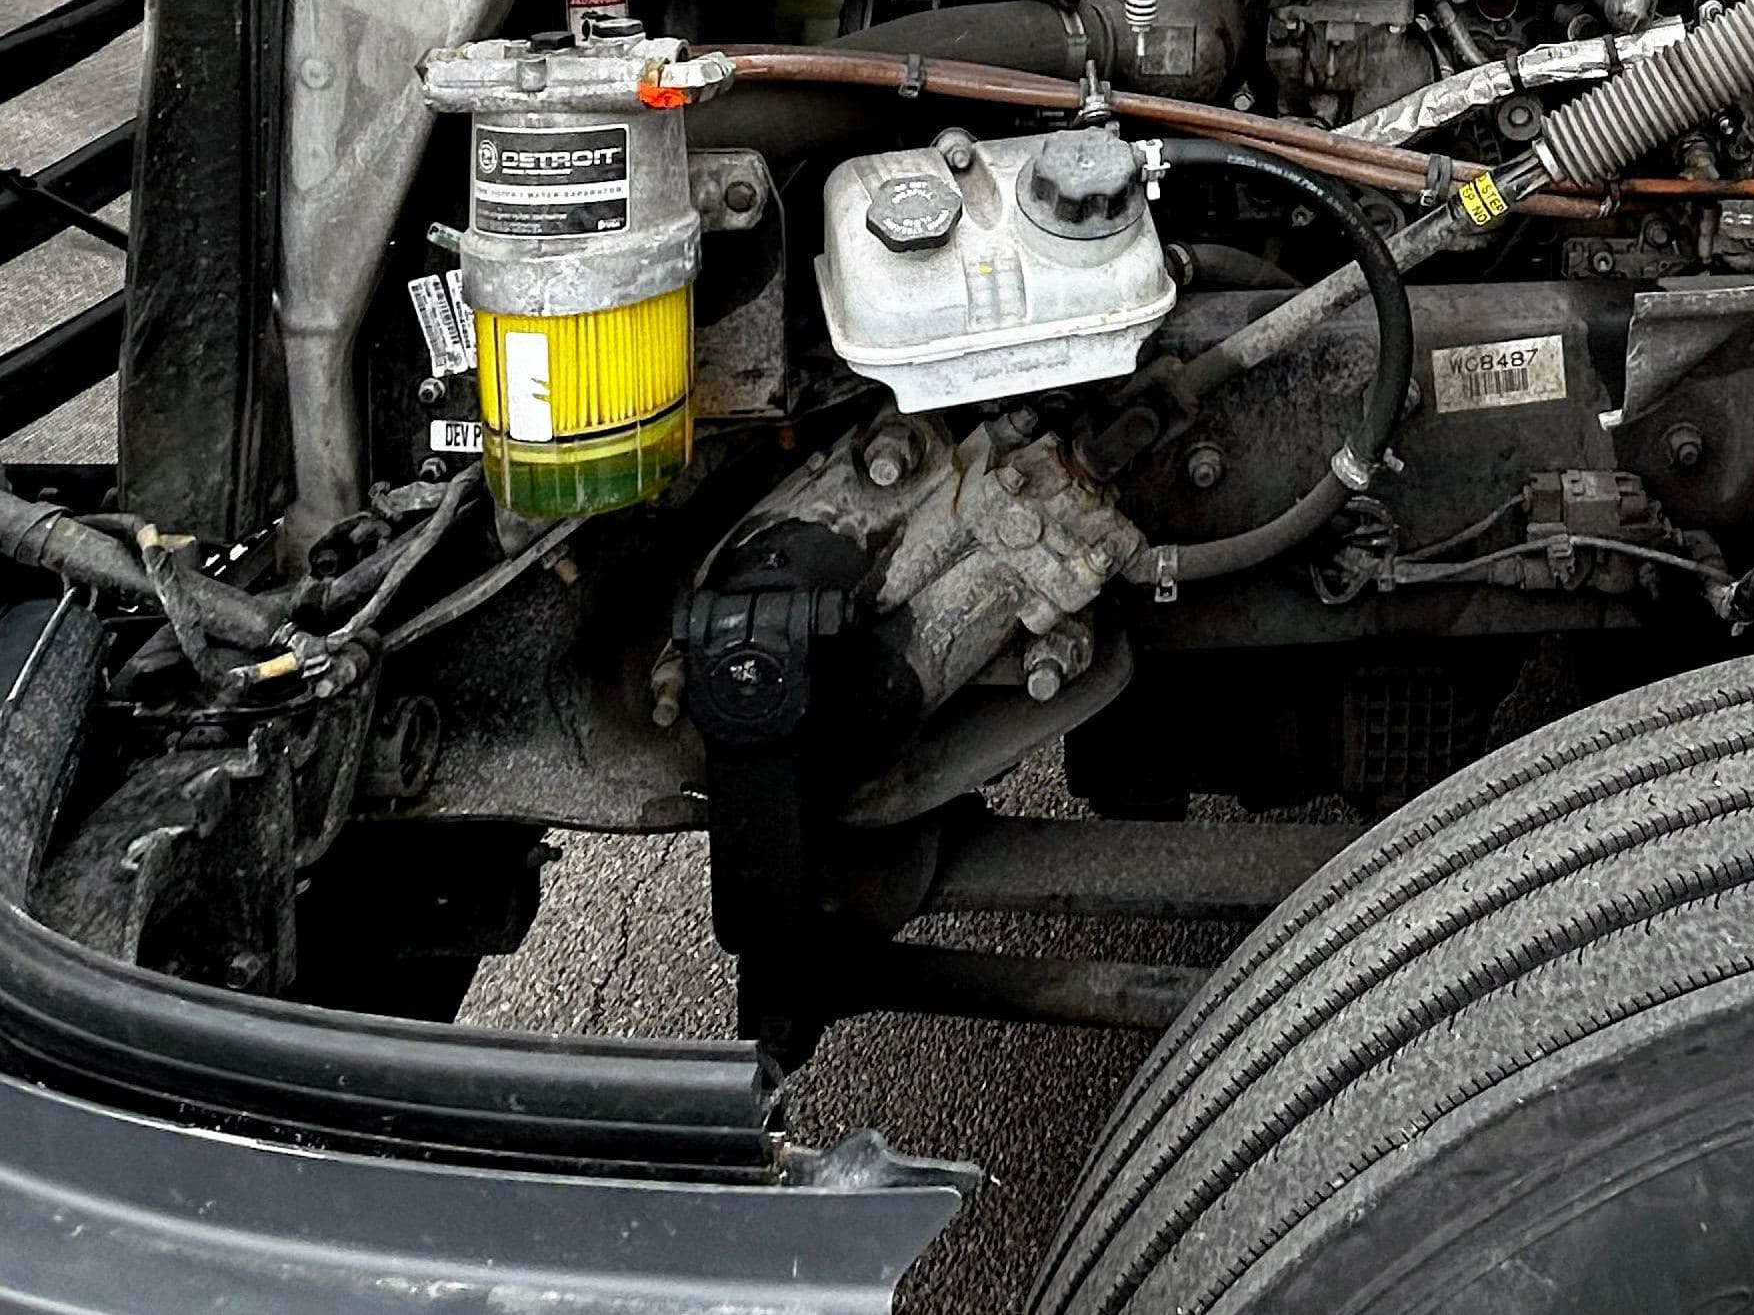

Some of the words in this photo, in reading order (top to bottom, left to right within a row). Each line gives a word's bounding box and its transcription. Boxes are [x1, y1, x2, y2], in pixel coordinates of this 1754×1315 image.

[501, 146, 621, 169] DETROIT
[1472, 206, 1488, 223] NO
[445, 423, 469, 447] DEV
